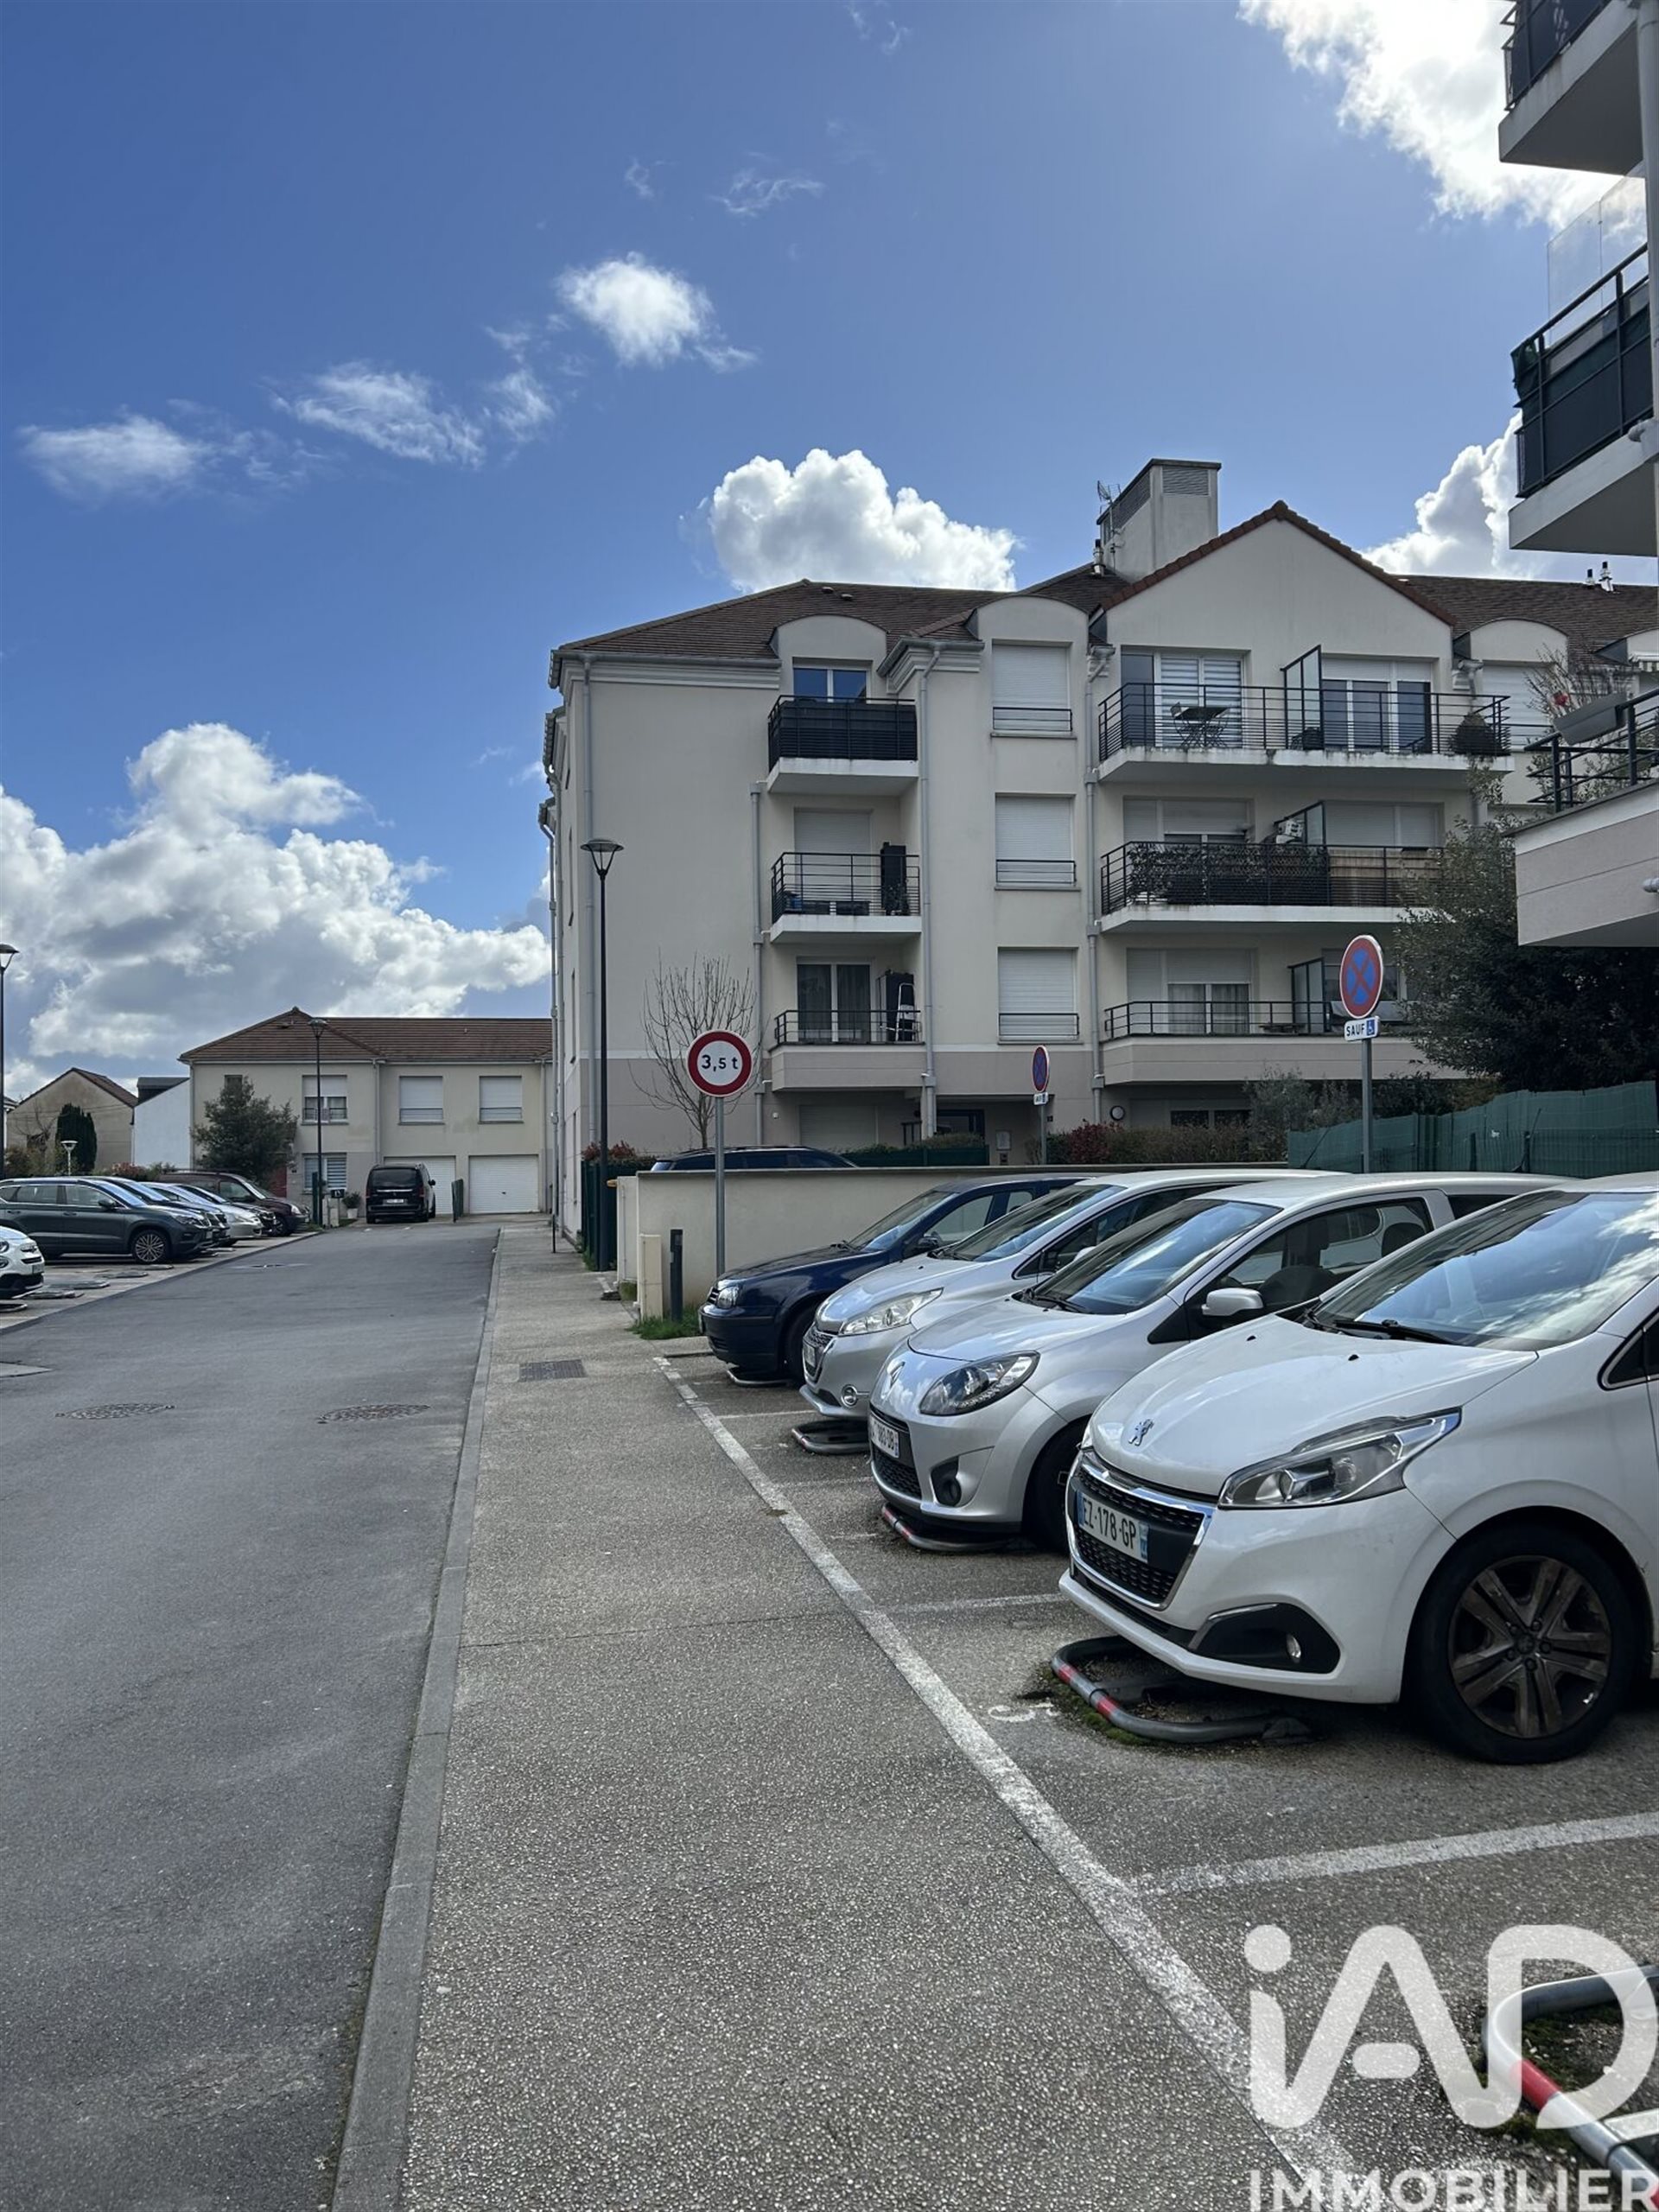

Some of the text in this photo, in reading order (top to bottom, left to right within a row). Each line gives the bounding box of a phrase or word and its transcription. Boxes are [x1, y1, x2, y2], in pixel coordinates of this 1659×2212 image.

[1346, 1023, 1365, 1037] SAUF
[701, 1054, 739, 1072] 3,5 t
